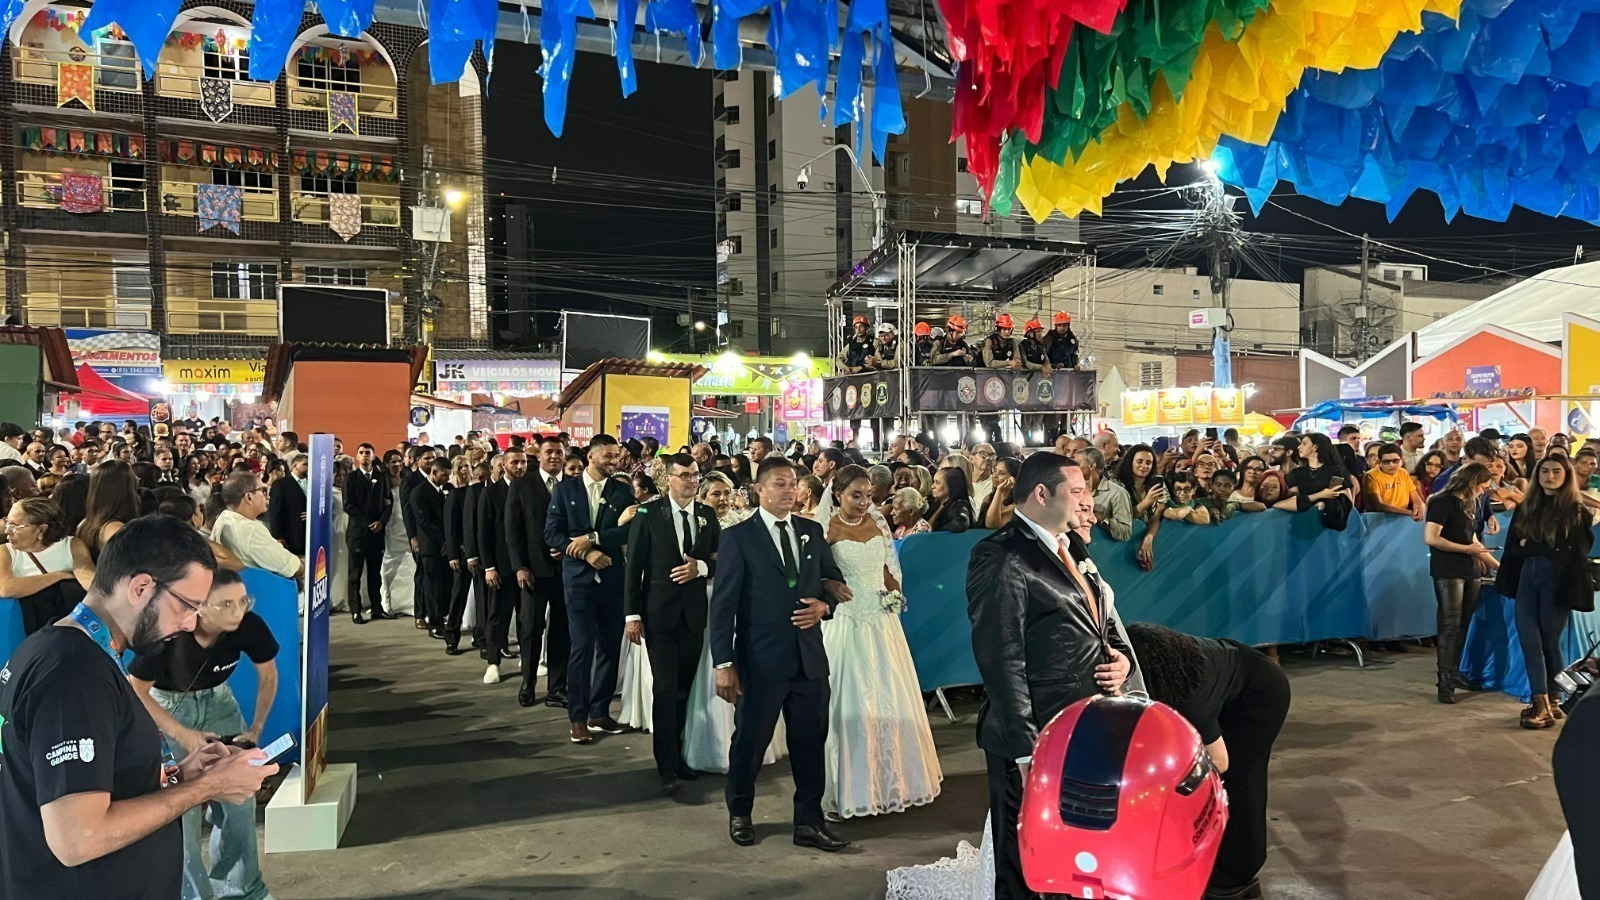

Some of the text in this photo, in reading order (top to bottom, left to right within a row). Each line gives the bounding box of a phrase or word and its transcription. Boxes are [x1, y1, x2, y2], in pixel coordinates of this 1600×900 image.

[180, 365, 231, 378] maxim
[438, 364, 465, 379] JK
[45, 744, 78, 760] CAMPINA
[50, 751, 79, 766] GRANDE
